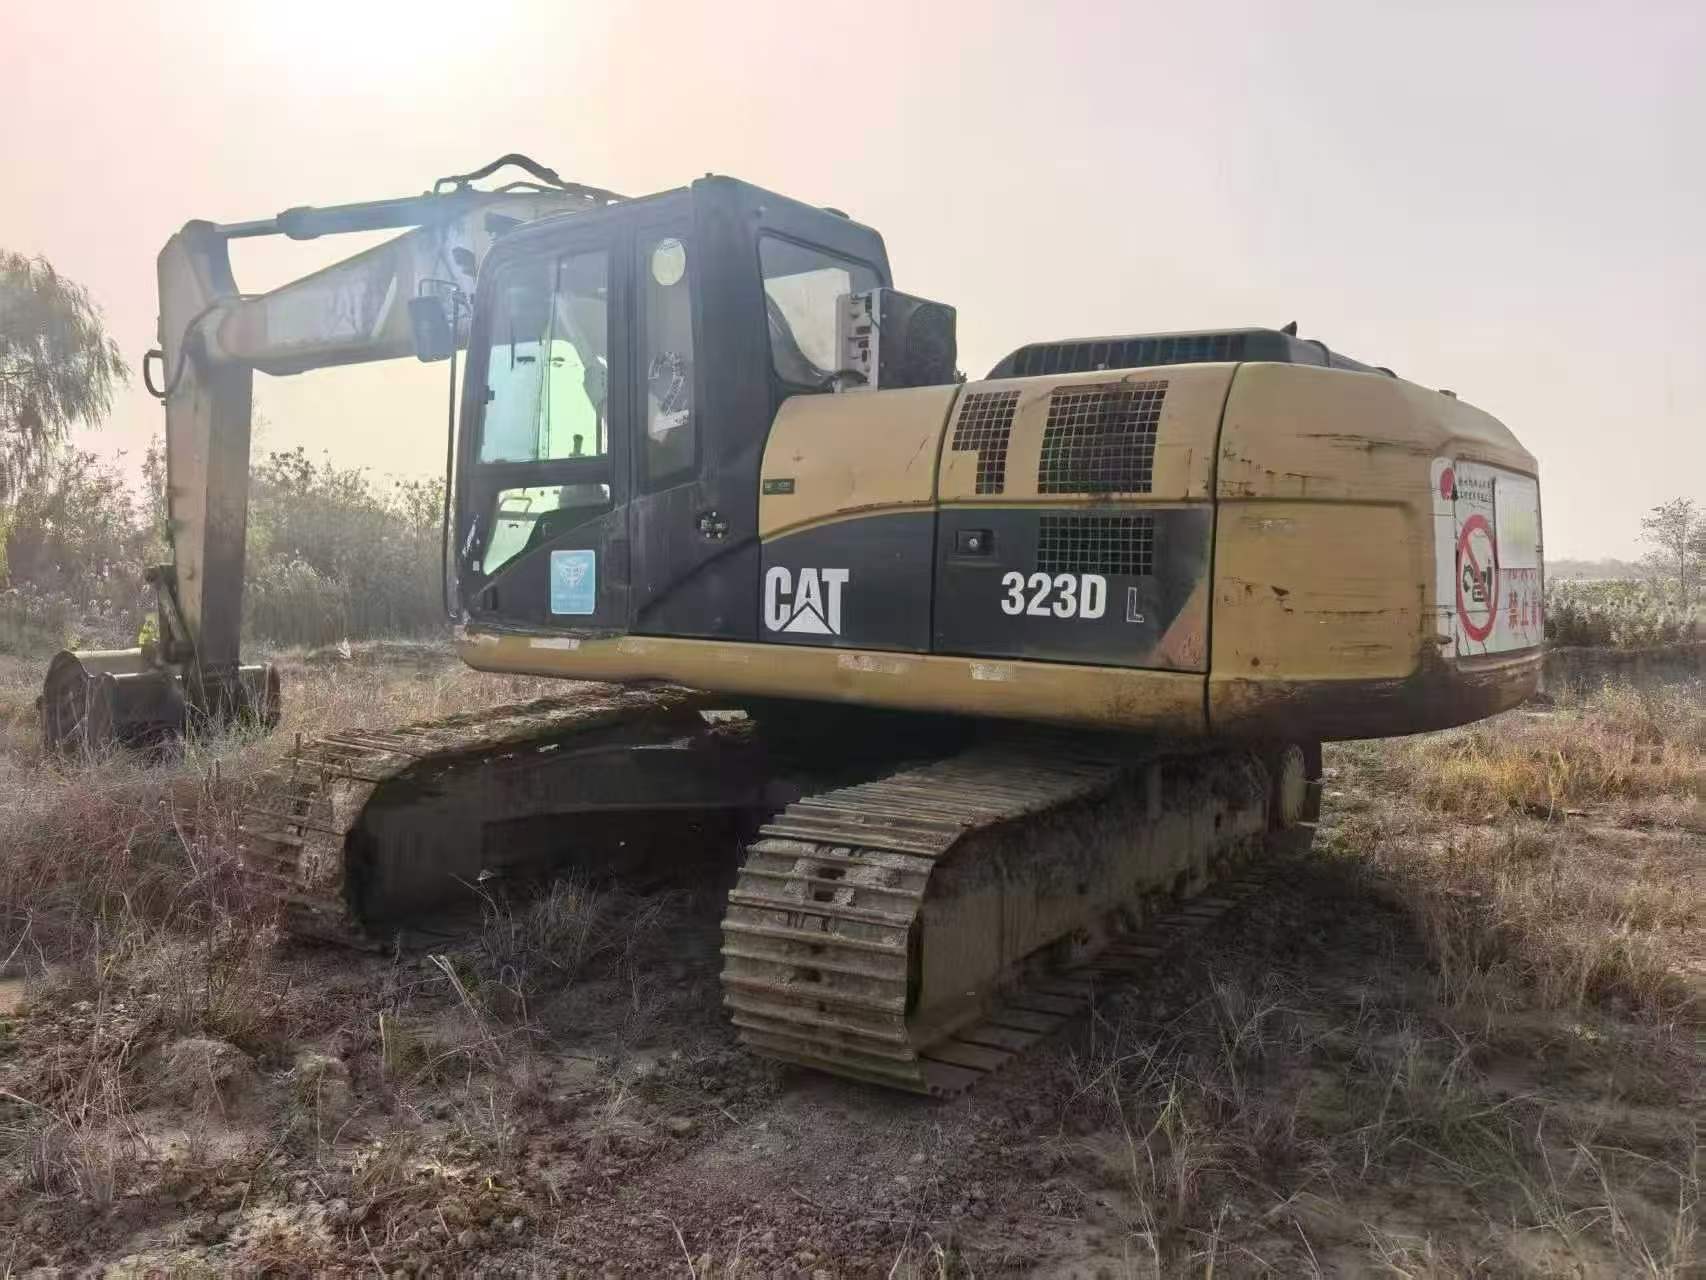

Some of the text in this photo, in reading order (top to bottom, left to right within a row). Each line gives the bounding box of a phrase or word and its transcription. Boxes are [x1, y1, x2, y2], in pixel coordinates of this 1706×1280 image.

[764, 566, 849, 635] CAT
[1001, 571, 1145, 622] 323D L
